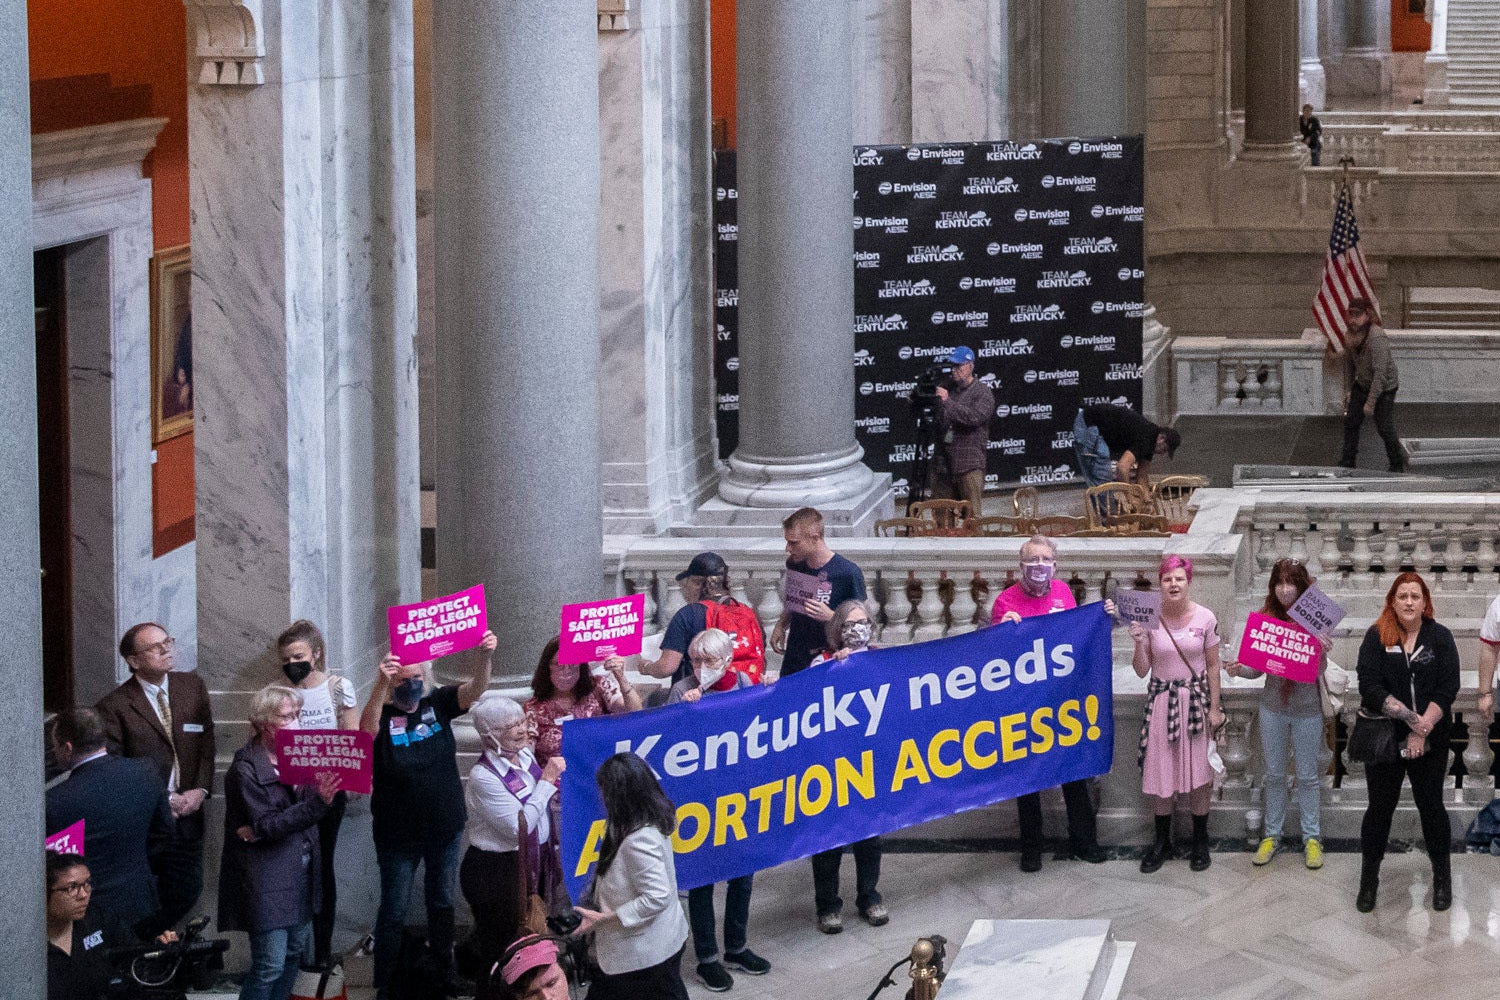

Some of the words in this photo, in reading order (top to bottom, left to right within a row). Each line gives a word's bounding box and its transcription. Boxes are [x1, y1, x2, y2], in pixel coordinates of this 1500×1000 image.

[992, 144, 1019, 153] TEAM
[1082, 142, 1123, 153] Envision
[921, 149, 965, 160] Envision
[987, 151, 1042, 161] KENTUCKY
[968, 177, 996, 186] TEAM
[1055, 176, 1097, 187] Envision
[894, 183, 937, 193] Envision
[963, 184, 1020, 195] KENTUCKY
[940, 211, 968, 220] TEAM
[1028, 209, 1070, 220] Envision
[1105, 205, 1145, 217] Envision
[865, 217, 909, 228] Envision
[935, 218, 992, 229] KENTUCKY
[1068, 237, 1096, 246] TEAM
[912, 245, 940, 254] TEAM
[1002, 243, 1043, 254] Envision
[1064, 244, 1118, 255] KENTUCKY
[907, 252, 965, 263] KENTUCKY
[1041, 271, 1069, 280] TEAM
[884, 280, 912, 289] TEAM
[974, 277, 1016, 288] Envision
[1037, 278, 1092, 288] KENTUCKY
[878, 286, 936, 297] KENTUCKY
[1014, 305, 1042, 314] TEAM
[855, 314, 883, 324] TEAM
[946, 311, 989, 322] Envision
[1010, 312, 1066, 322] KENTUCKY
[983, 339, 1011, 349] TEAM
[1074, 335, 1116, 346] Envision
[978, 346, 1034, 357] KENTUCKY
[1110, 364, 1137, 372] TEAM
[1038, 369, 1080, 380] Envision
[1083, 397, 1110, 406] TEAM
[1010, 404, 1052, 415] Envision
[1020, 473, 1075, 484] KENTUCKY
[1306, 592, 1328, 611] BANS
[408, 596, 470, 621] PROTECT
[580, 602, 633, 619] PROTECT
[1134, 606, 1153, 615] OUR
[397, 619, 437, 635] SAFE,
[439, 605, 481, 624] LEGAL
[568, 618, 607, 632] SAFE,
[608, 612, 639, 628] LEGAL
[1294, 605, 1323, 630] BODIES
[1315, 611, 1332, 627] OUR
[404, 617, 477, 646] ABORTION
[573, 624, 635, 643] ABORTION
[1261, 621, 1311, 643] PROTECT
[1250, 629, 1280, 647] SAFE,
[1282, 636, 1316, 655] LEGAL
[1250, 641, 1311, 664] ABORTION
[615, 683, 891, 780] Kentucky
[908, 638, 1075, 711] needs
[294, 735, 356, 746] PROTECT
[284, 746, 323, 757] SAFE,
[326, 748, 367, 760] LEGAL
[290, 758, 361, 770] ABORTION
[574, 750, 876, 877] AORTION
[890, 694, 1101, 793] ACCESS!
